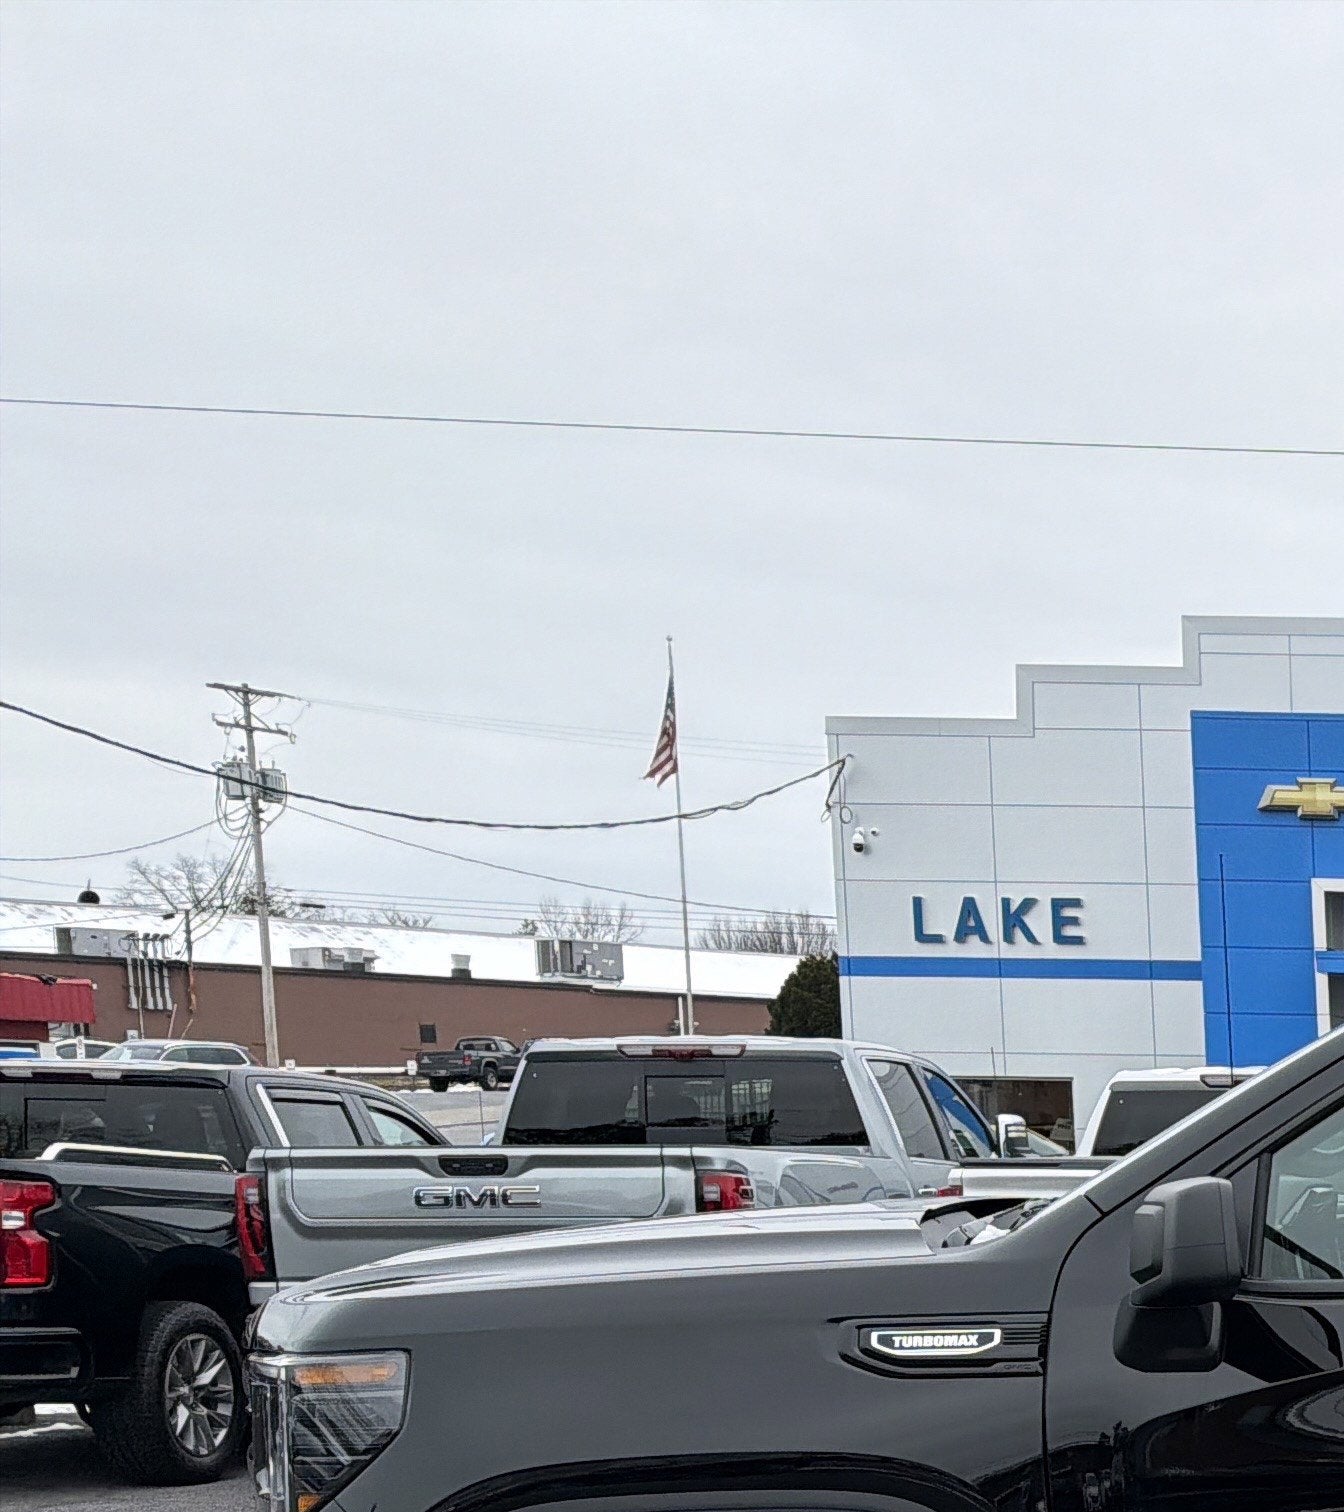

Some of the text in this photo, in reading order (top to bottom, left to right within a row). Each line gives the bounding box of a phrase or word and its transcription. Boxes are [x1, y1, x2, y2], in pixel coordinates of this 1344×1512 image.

[911, 895, 1087, 946] LAKE
[412, 1184, 542, 1210] GMC
[891, 1334, 979, 1348] TURBOMAX
